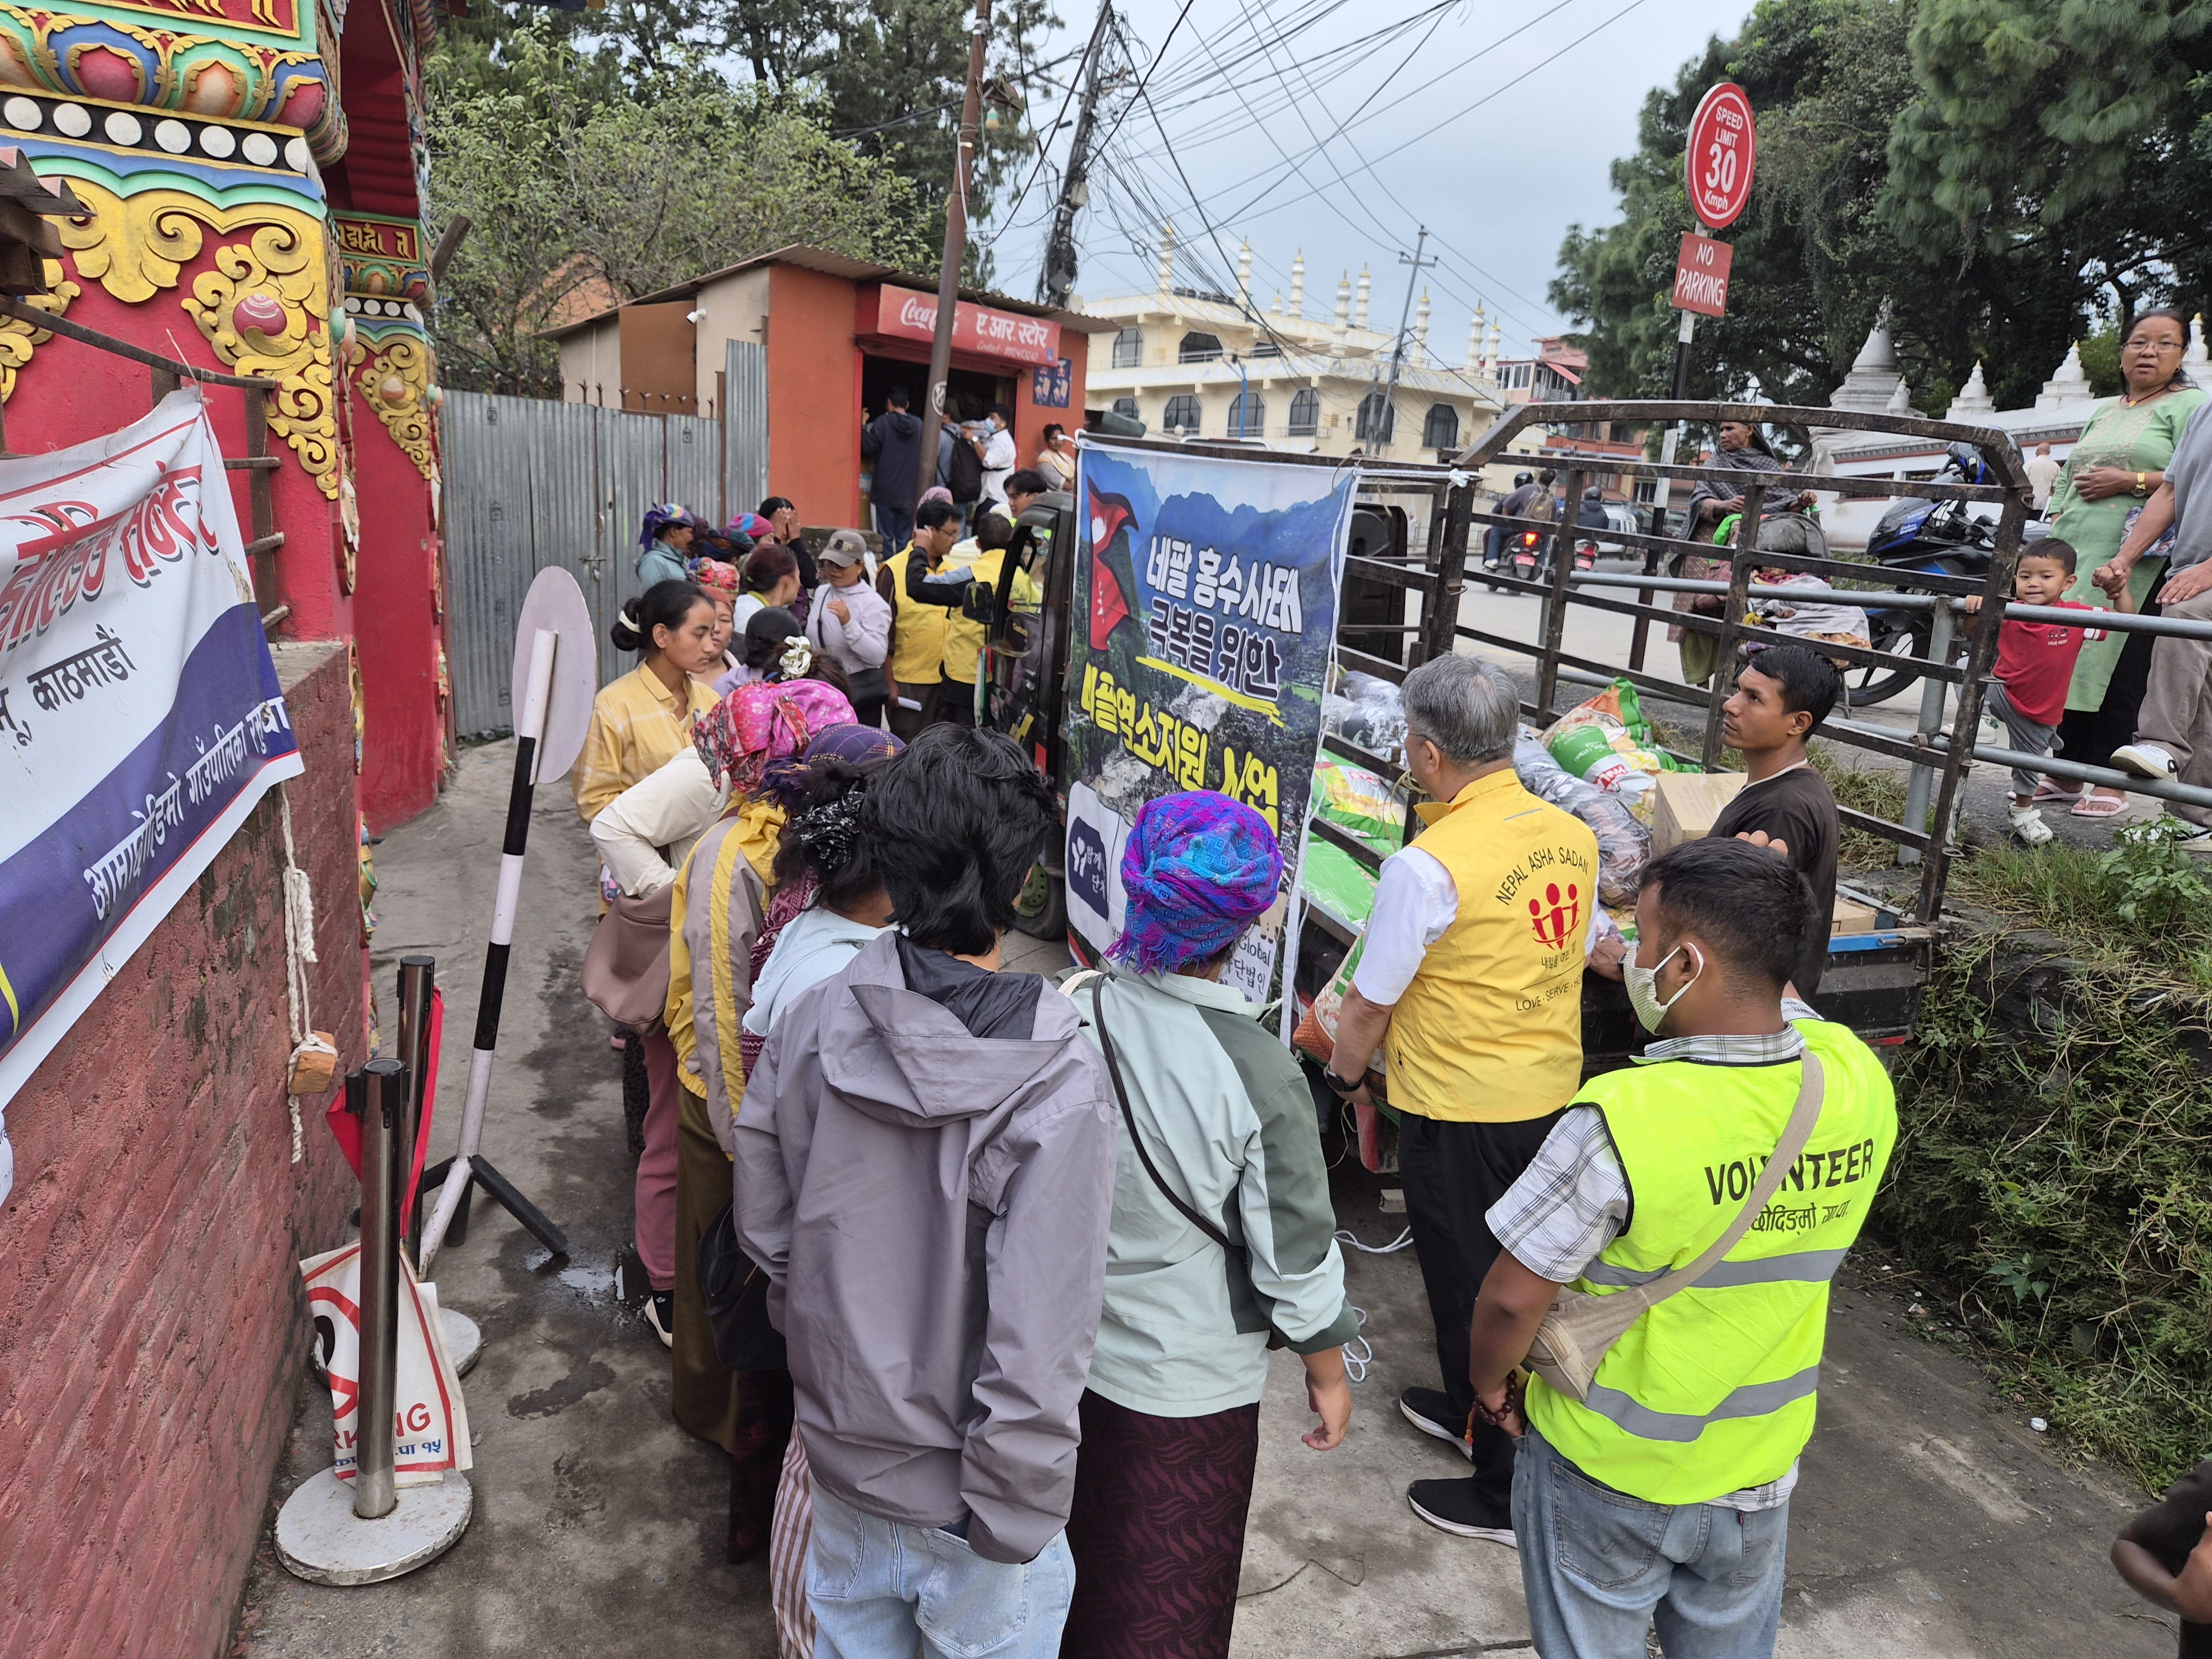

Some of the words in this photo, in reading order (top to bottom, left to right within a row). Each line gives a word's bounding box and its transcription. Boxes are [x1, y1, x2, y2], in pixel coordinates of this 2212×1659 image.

[1716, 105, 1743, 131] SPEED
[1715, 127, 1738, 148] LIMIT
[1705, 143, 1736, 194] 30
[1704, 189, 1728, 211] Kmph
[1696, 243, 1714, 266] NO
[1675, 268, 1724, 309] PARKING
[1018, 320, 1049, 348] स्टोर
[1146, 535, 1192, 599] 네팔
[1193, 546, 1302, 634] 홍수사태
[1149, 596, 1214, 676] 극복을
[1217, 624, 1282, 702] 위한
[1495, 864, 1528, 906] NEPAL
[1528, 847, 1555, 873] ASHA
[1558, 847, 1588, 875] SADAN
[1541, 955, 1558, 969] 내일을
[1516, 995, 1542, 1011] LOVE
[1545, 982, 1569, 1001] SERVE
[1574, 972, 1582, 989] HO
[1704, 1138, 1874, 1206] VOLNTEER
[421, 1439, 441, 1454] १५
